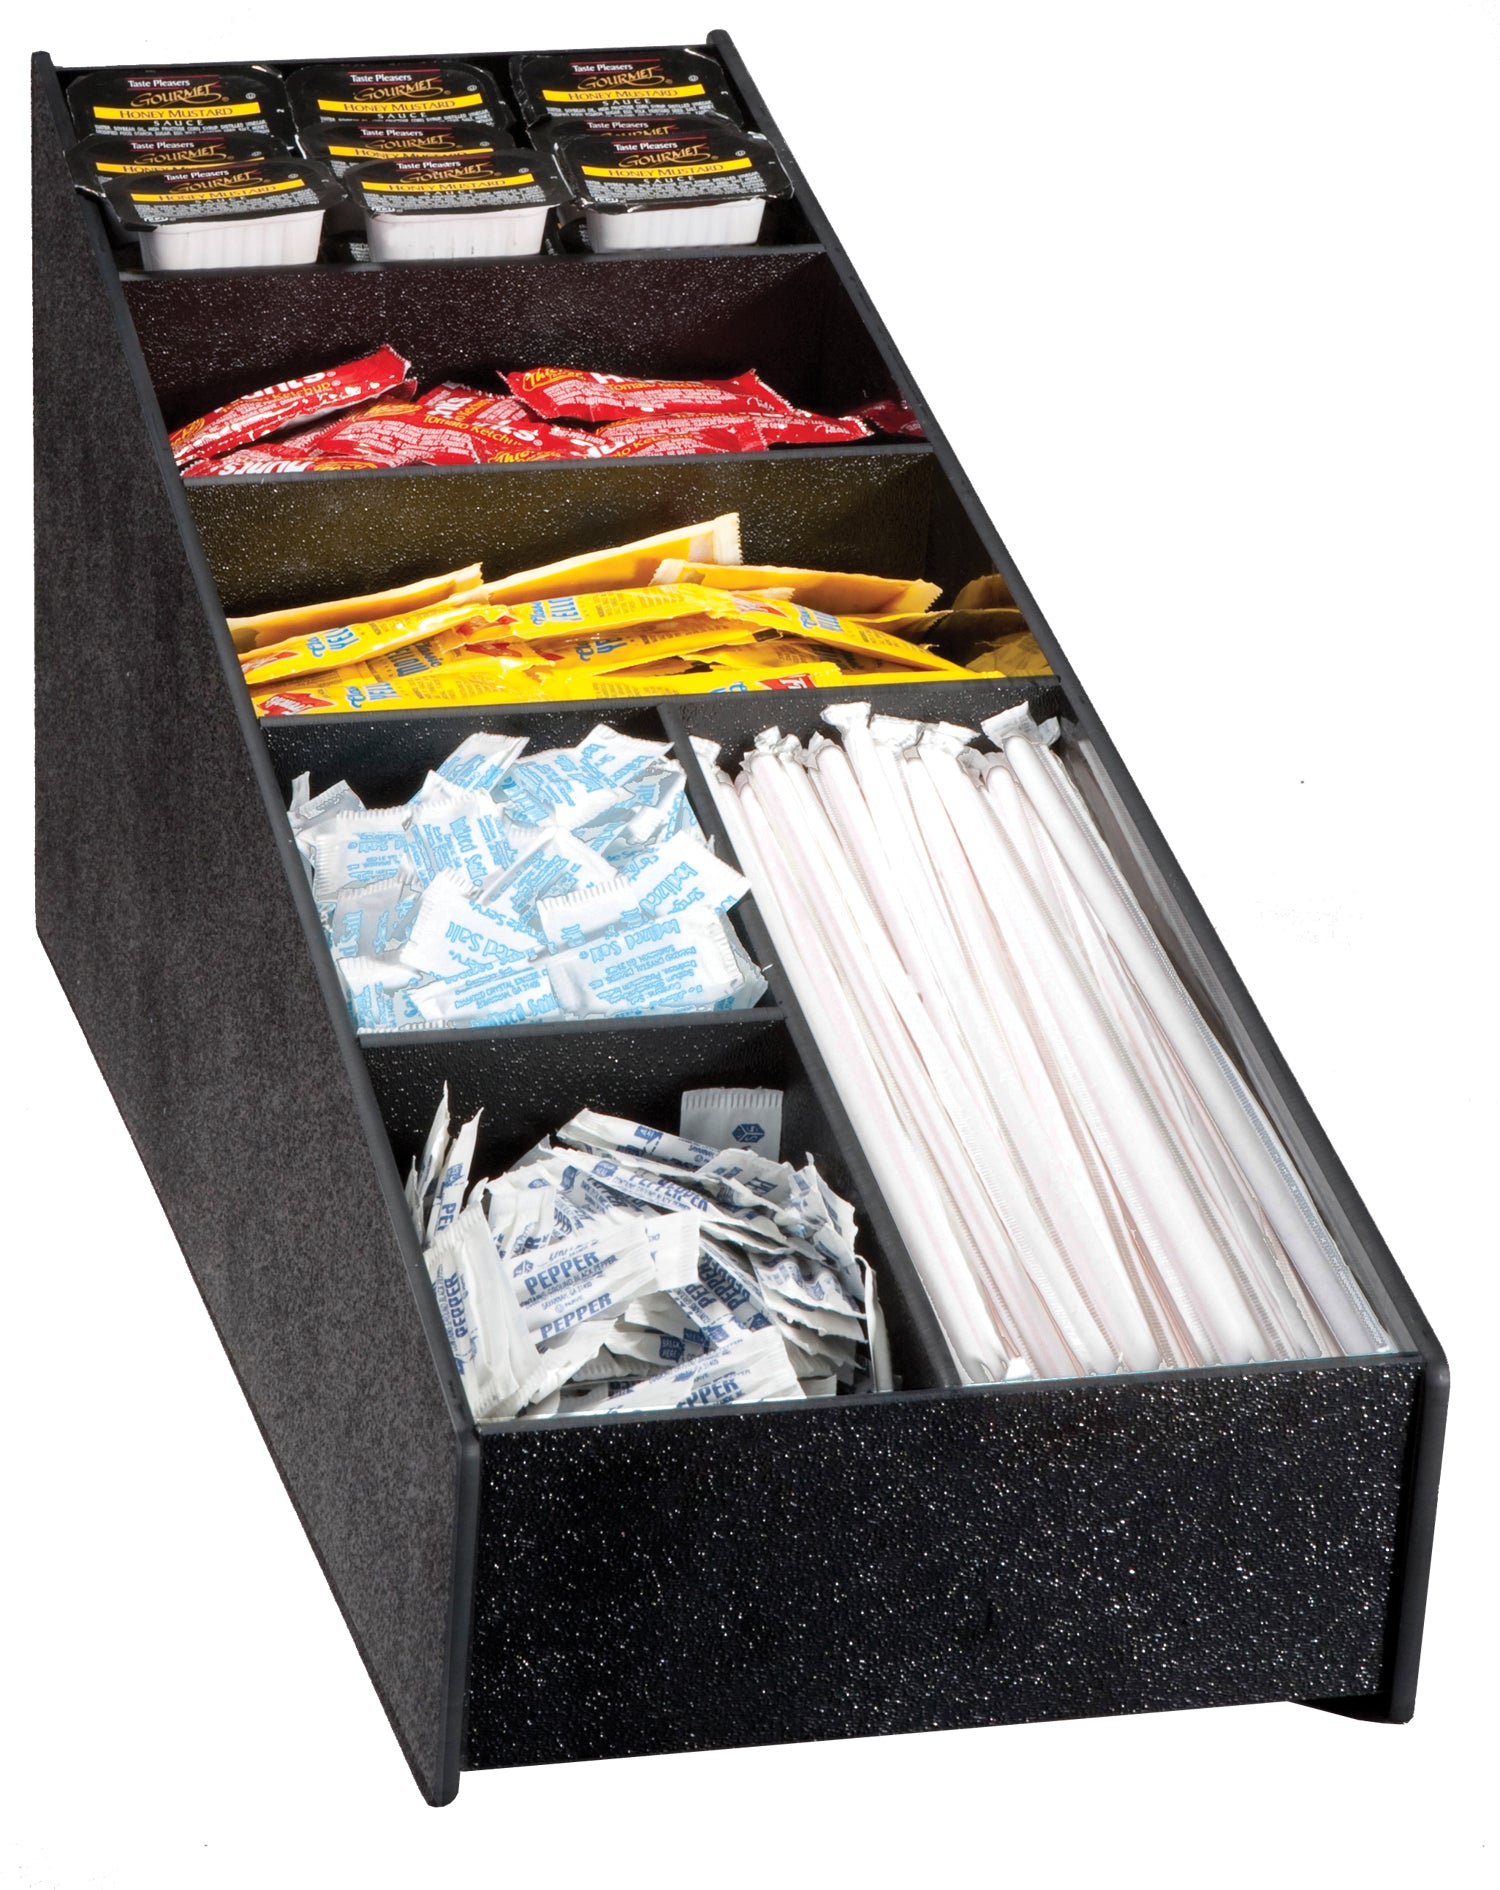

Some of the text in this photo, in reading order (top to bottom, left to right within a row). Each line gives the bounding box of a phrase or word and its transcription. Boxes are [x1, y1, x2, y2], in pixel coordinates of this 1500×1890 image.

[573, 63, 634, 73] Taste Pleasers
[128, 79, 190, 88] Taste Pleasers
[351, 74, 413, 83] Taste Pleasers
[577, 67, 666, 91] GOURMET
[130, 82, 223, 107] GOURMET
[353, 77, 444, 102] GOURMET
[568, 87, 679, 101] HONEY MUSTARD
[119, 107, 233, 119] HONEY MUSTARD
[343, 100, 456, 112] HONEY MUSTARD
[361, 128, 424, 137] Taste Pleasers
[587, 121, 649, 130] Taste Pleasers
[131, 141, 195, 150] Taste Pleasers
[365, 135, 456, 150] GOURMET
[614, 141, 678, 152] Taste Pleasers
[133, 145, 227, 165] GOURMET
[618, 145, 711, 168] GOURMET
[397, 160, 461, 170] Taste Pleasers
[608, 164, 724, 178] HONEY MUSTARD
[165, 170, 230, 181] Taste Pleasers
[400, 163, 494, 183] GOURMET
[169, 172, 264, 193] GOURMET
[439, 179, 506, 191] MUSTARD
[158, 185, 277, 201] HONEY MUSTARD
[272, 382, 331, 402] Ketchup
[423, 414, 469, 430] Tomato
[444, 921, 484, 952] Salt
[589, 940, 622, 964] Salt
[524, 1251, 601, 1296] PEPPER
[443, 1271, 469, 1339] PEPPER
[540, 1292, 612, 1340] PEPPER
